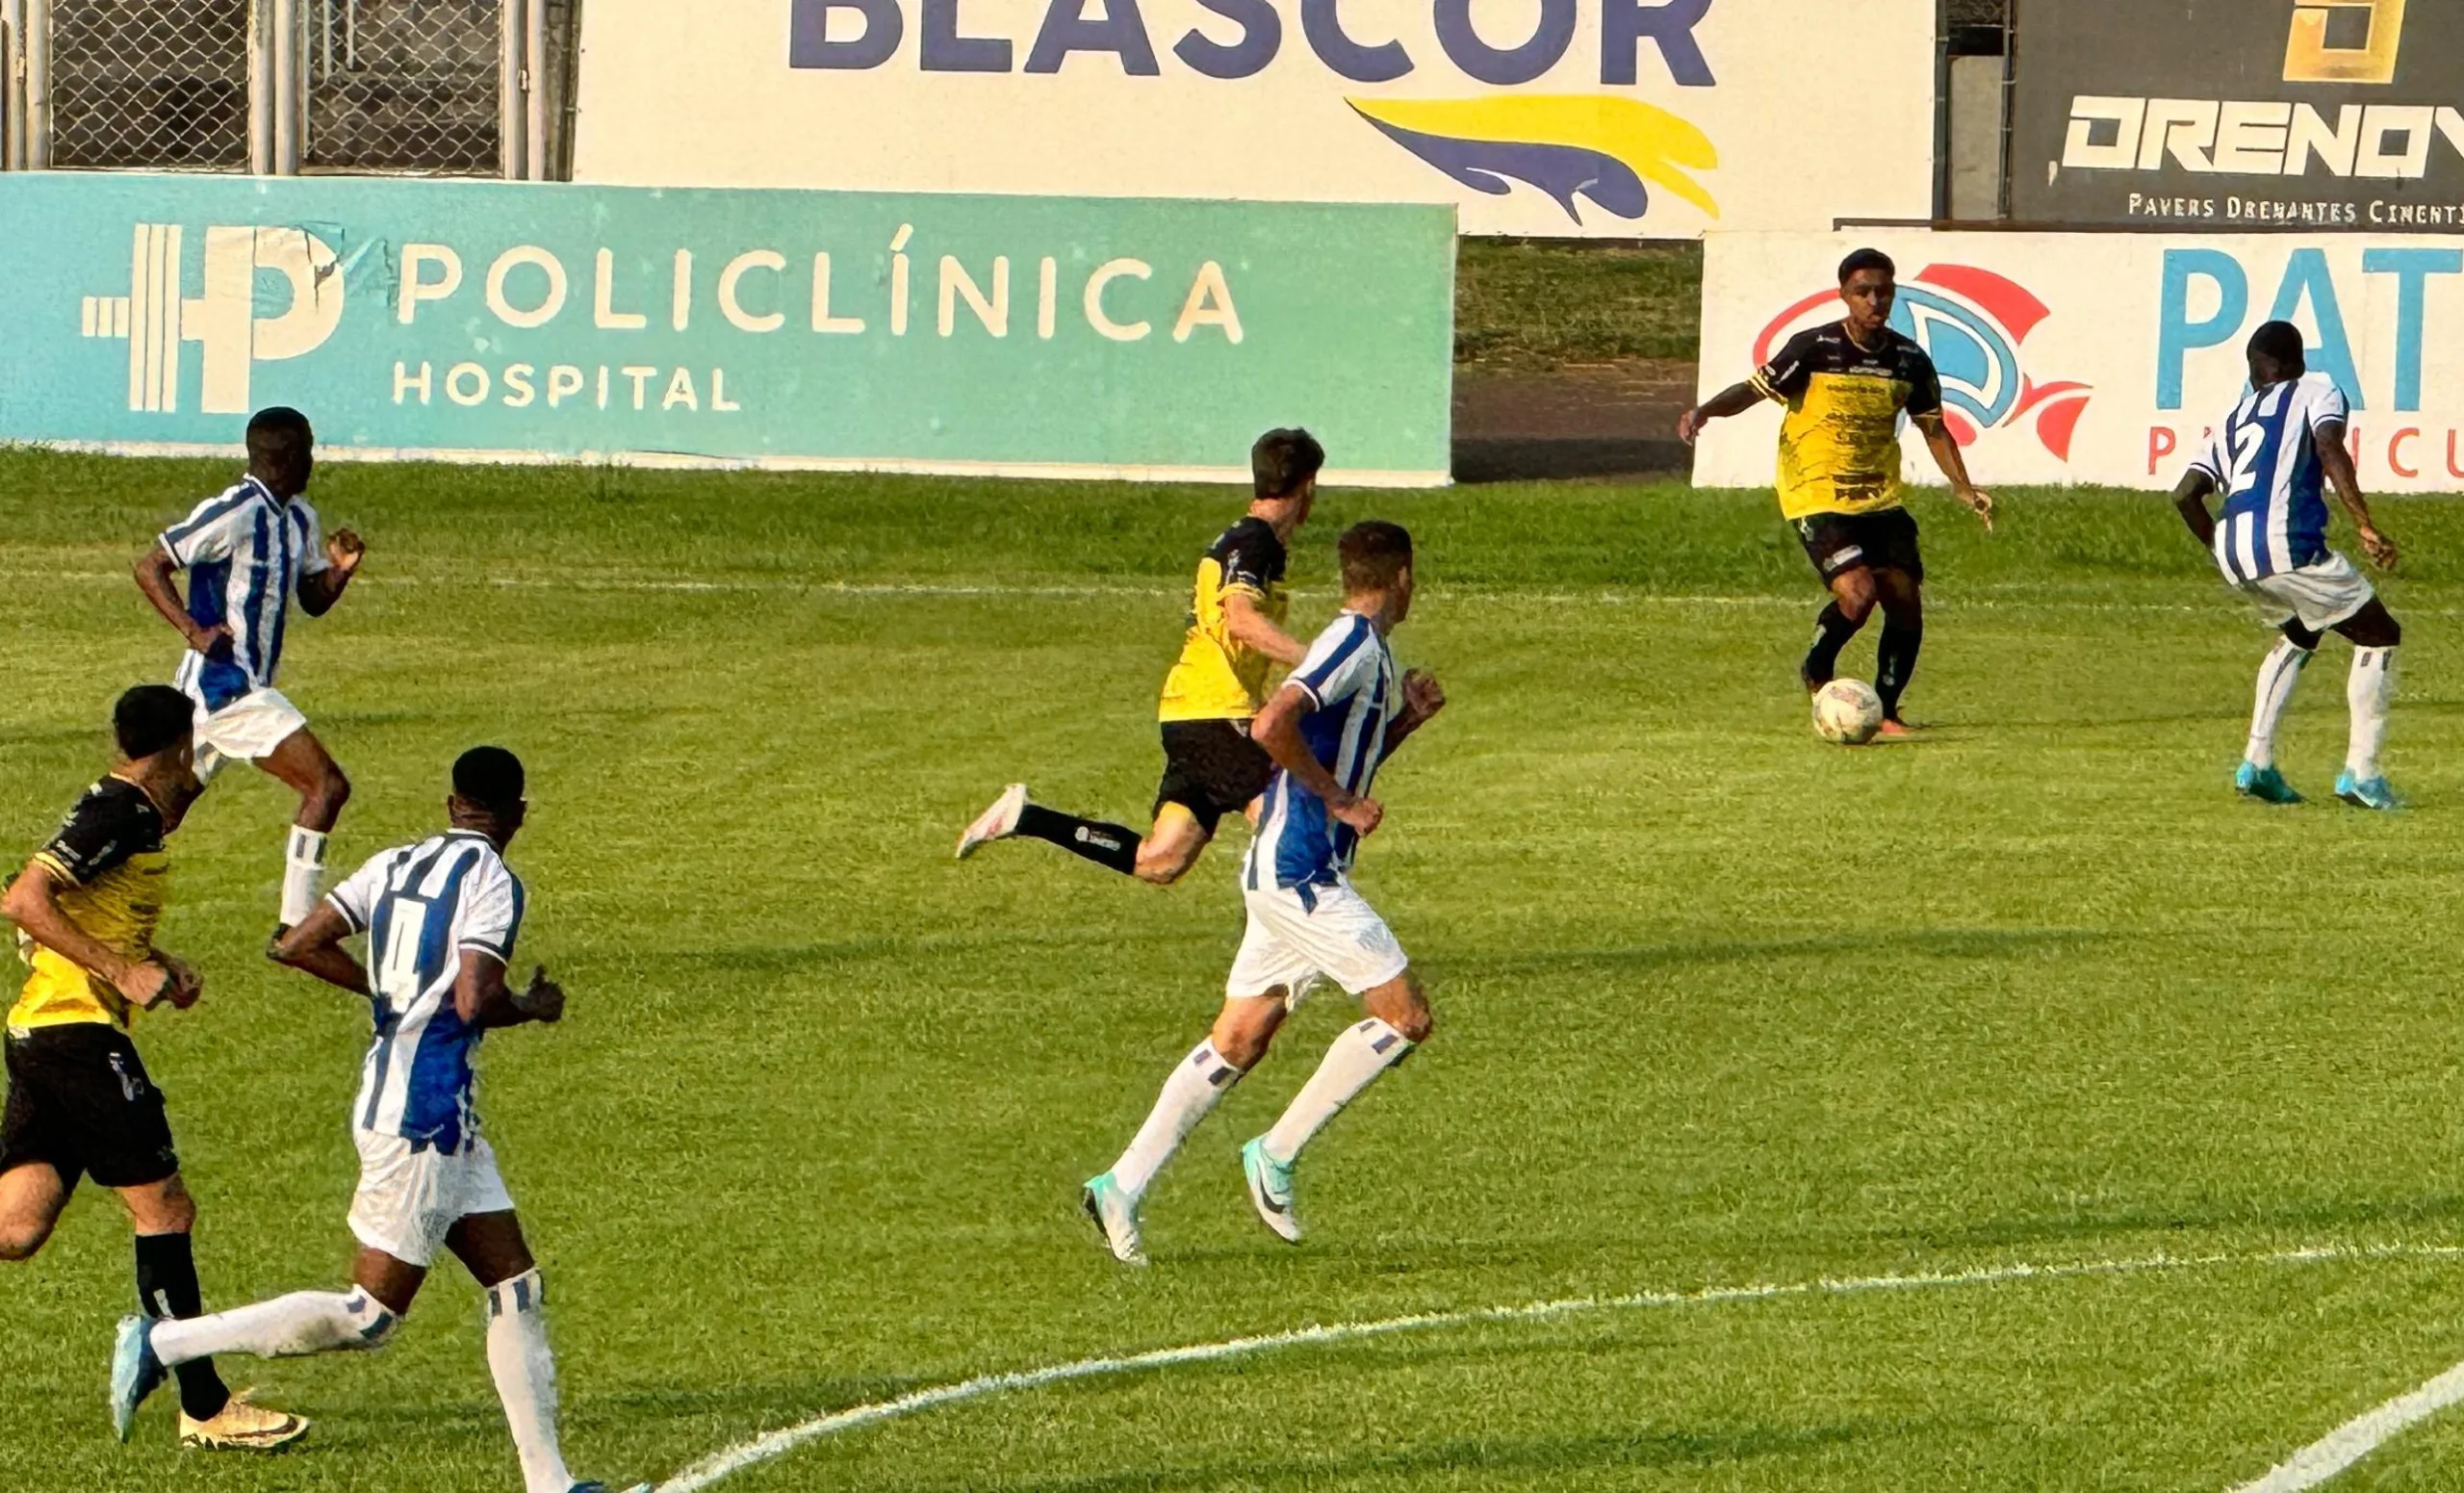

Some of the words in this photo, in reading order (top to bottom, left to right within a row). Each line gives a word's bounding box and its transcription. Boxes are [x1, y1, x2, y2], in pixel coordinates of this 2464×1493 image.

[789, 0, 1716, 86] BLASCOR
[2128, 193, 2214, 218] PAVERS
[397, 222, 1245, 344] POLICLÍNICA
[2156, 247, 2463, 411] PAT
[392, 360, 741, 411] HOSPITAL
